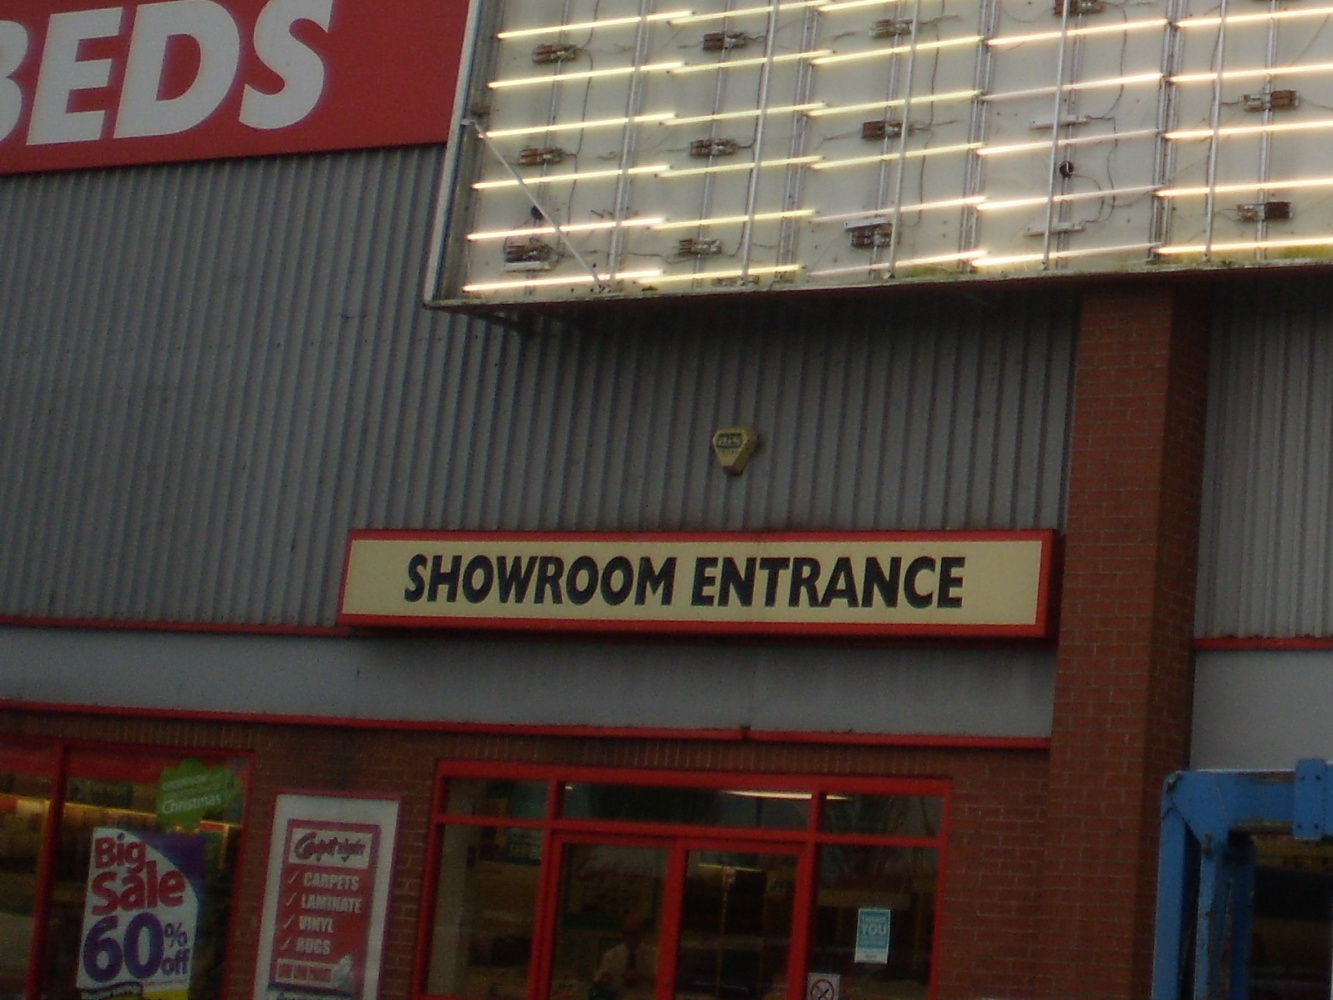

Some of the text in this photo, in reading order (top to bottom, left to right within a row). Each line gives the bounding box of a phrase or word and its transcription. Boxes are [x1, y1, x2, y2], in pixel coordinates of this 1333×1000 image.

[404, 553, 967, 609] SHOWROOM ENTRANCE
[94, 831, 147, 874] Big
[91, 860, 187, 916] Sale
[303, 871, 360, 891] CARPETS
[300, 893, 363, 913] LAMINATE
[299, 915, 335, 933] VINYL
[296, 936, 332, 955] RUGS
[161, 948, 191, 976] off
